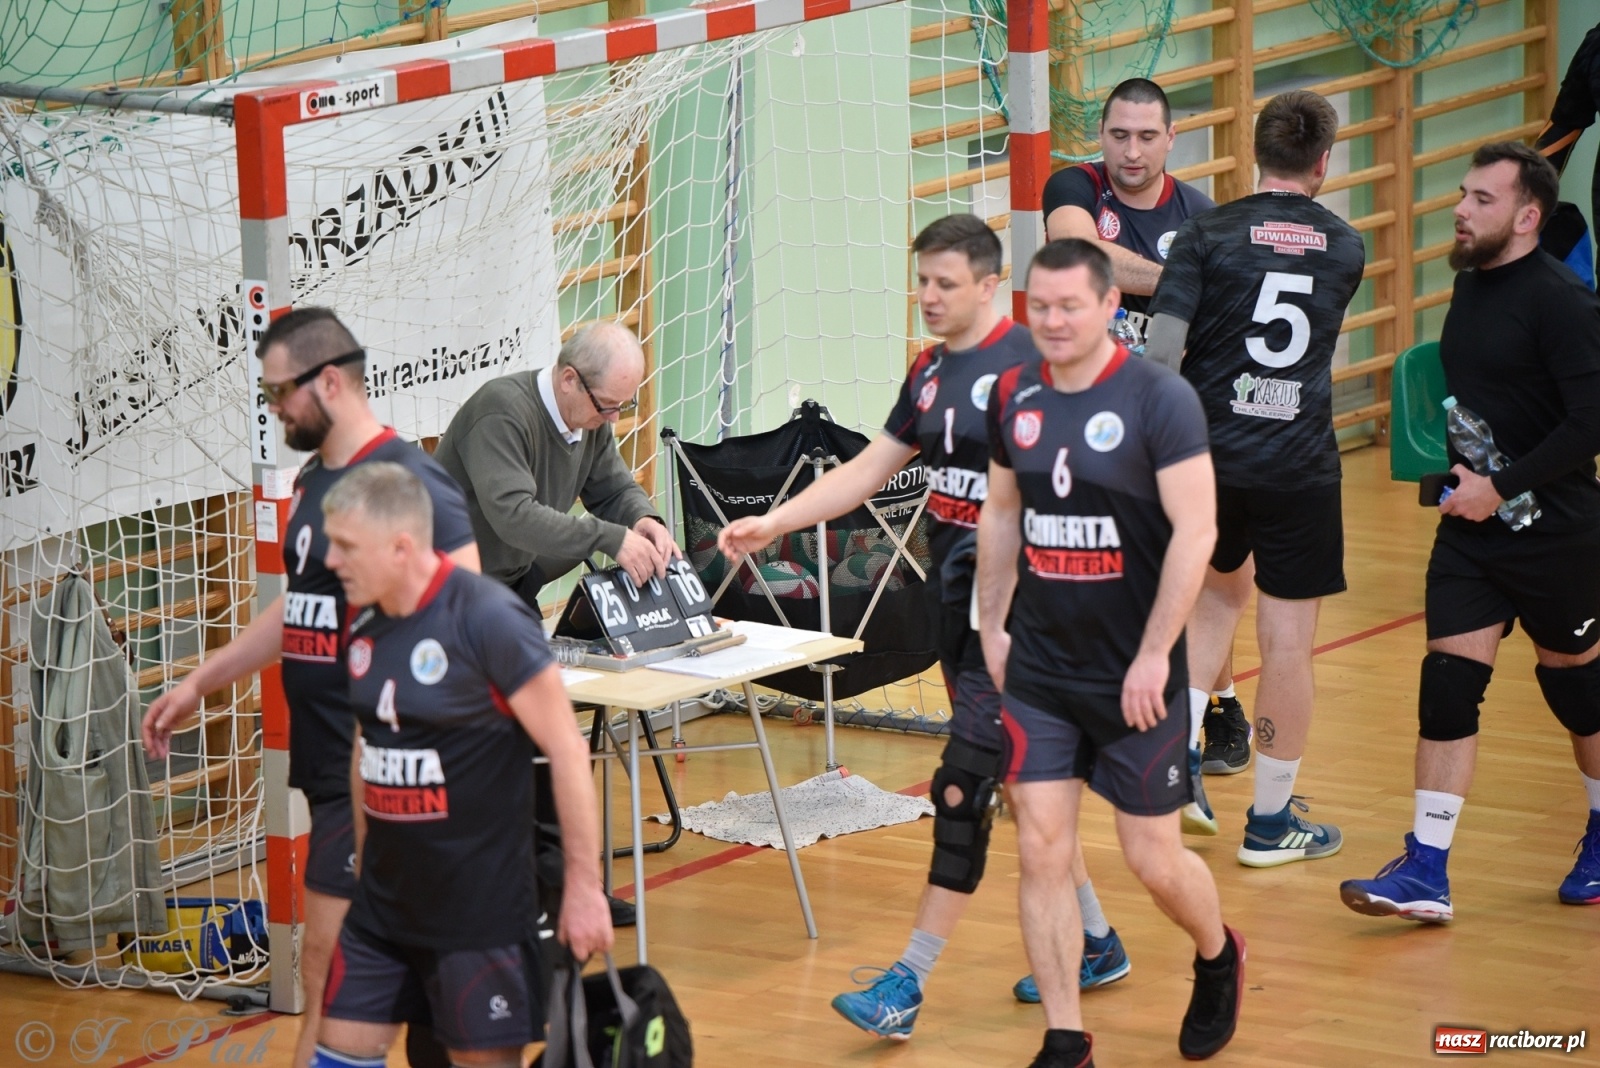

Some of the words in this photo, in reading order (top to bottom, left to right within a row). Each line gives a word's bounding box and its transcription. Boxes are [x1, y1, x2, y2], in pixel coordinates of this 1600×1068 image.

[346, 83, 380, 107] sport
[1256, 230, 1322, 246] PIWIARNIA
[1244, 271, 1315, 369] 5
[1234, 406, 1253, 415] CHILL
[1254, 377, 1302, 407] KAKTUS
[943, 407, 955, 454] 1
[0, 442, 40, 498] RZ
[1051, 447, 1072, 499] 6
[295, 523, 313, 576] 9
[590, 580, 629, 628] 25
[667, 560, 706, 606] 16
[635, 607, 672, 629] JOOLA
[375, 678, 400, 733] 4
[1425, 811, 1450, 821] PUMA
[129, 938, 193, 954] MIKASA
